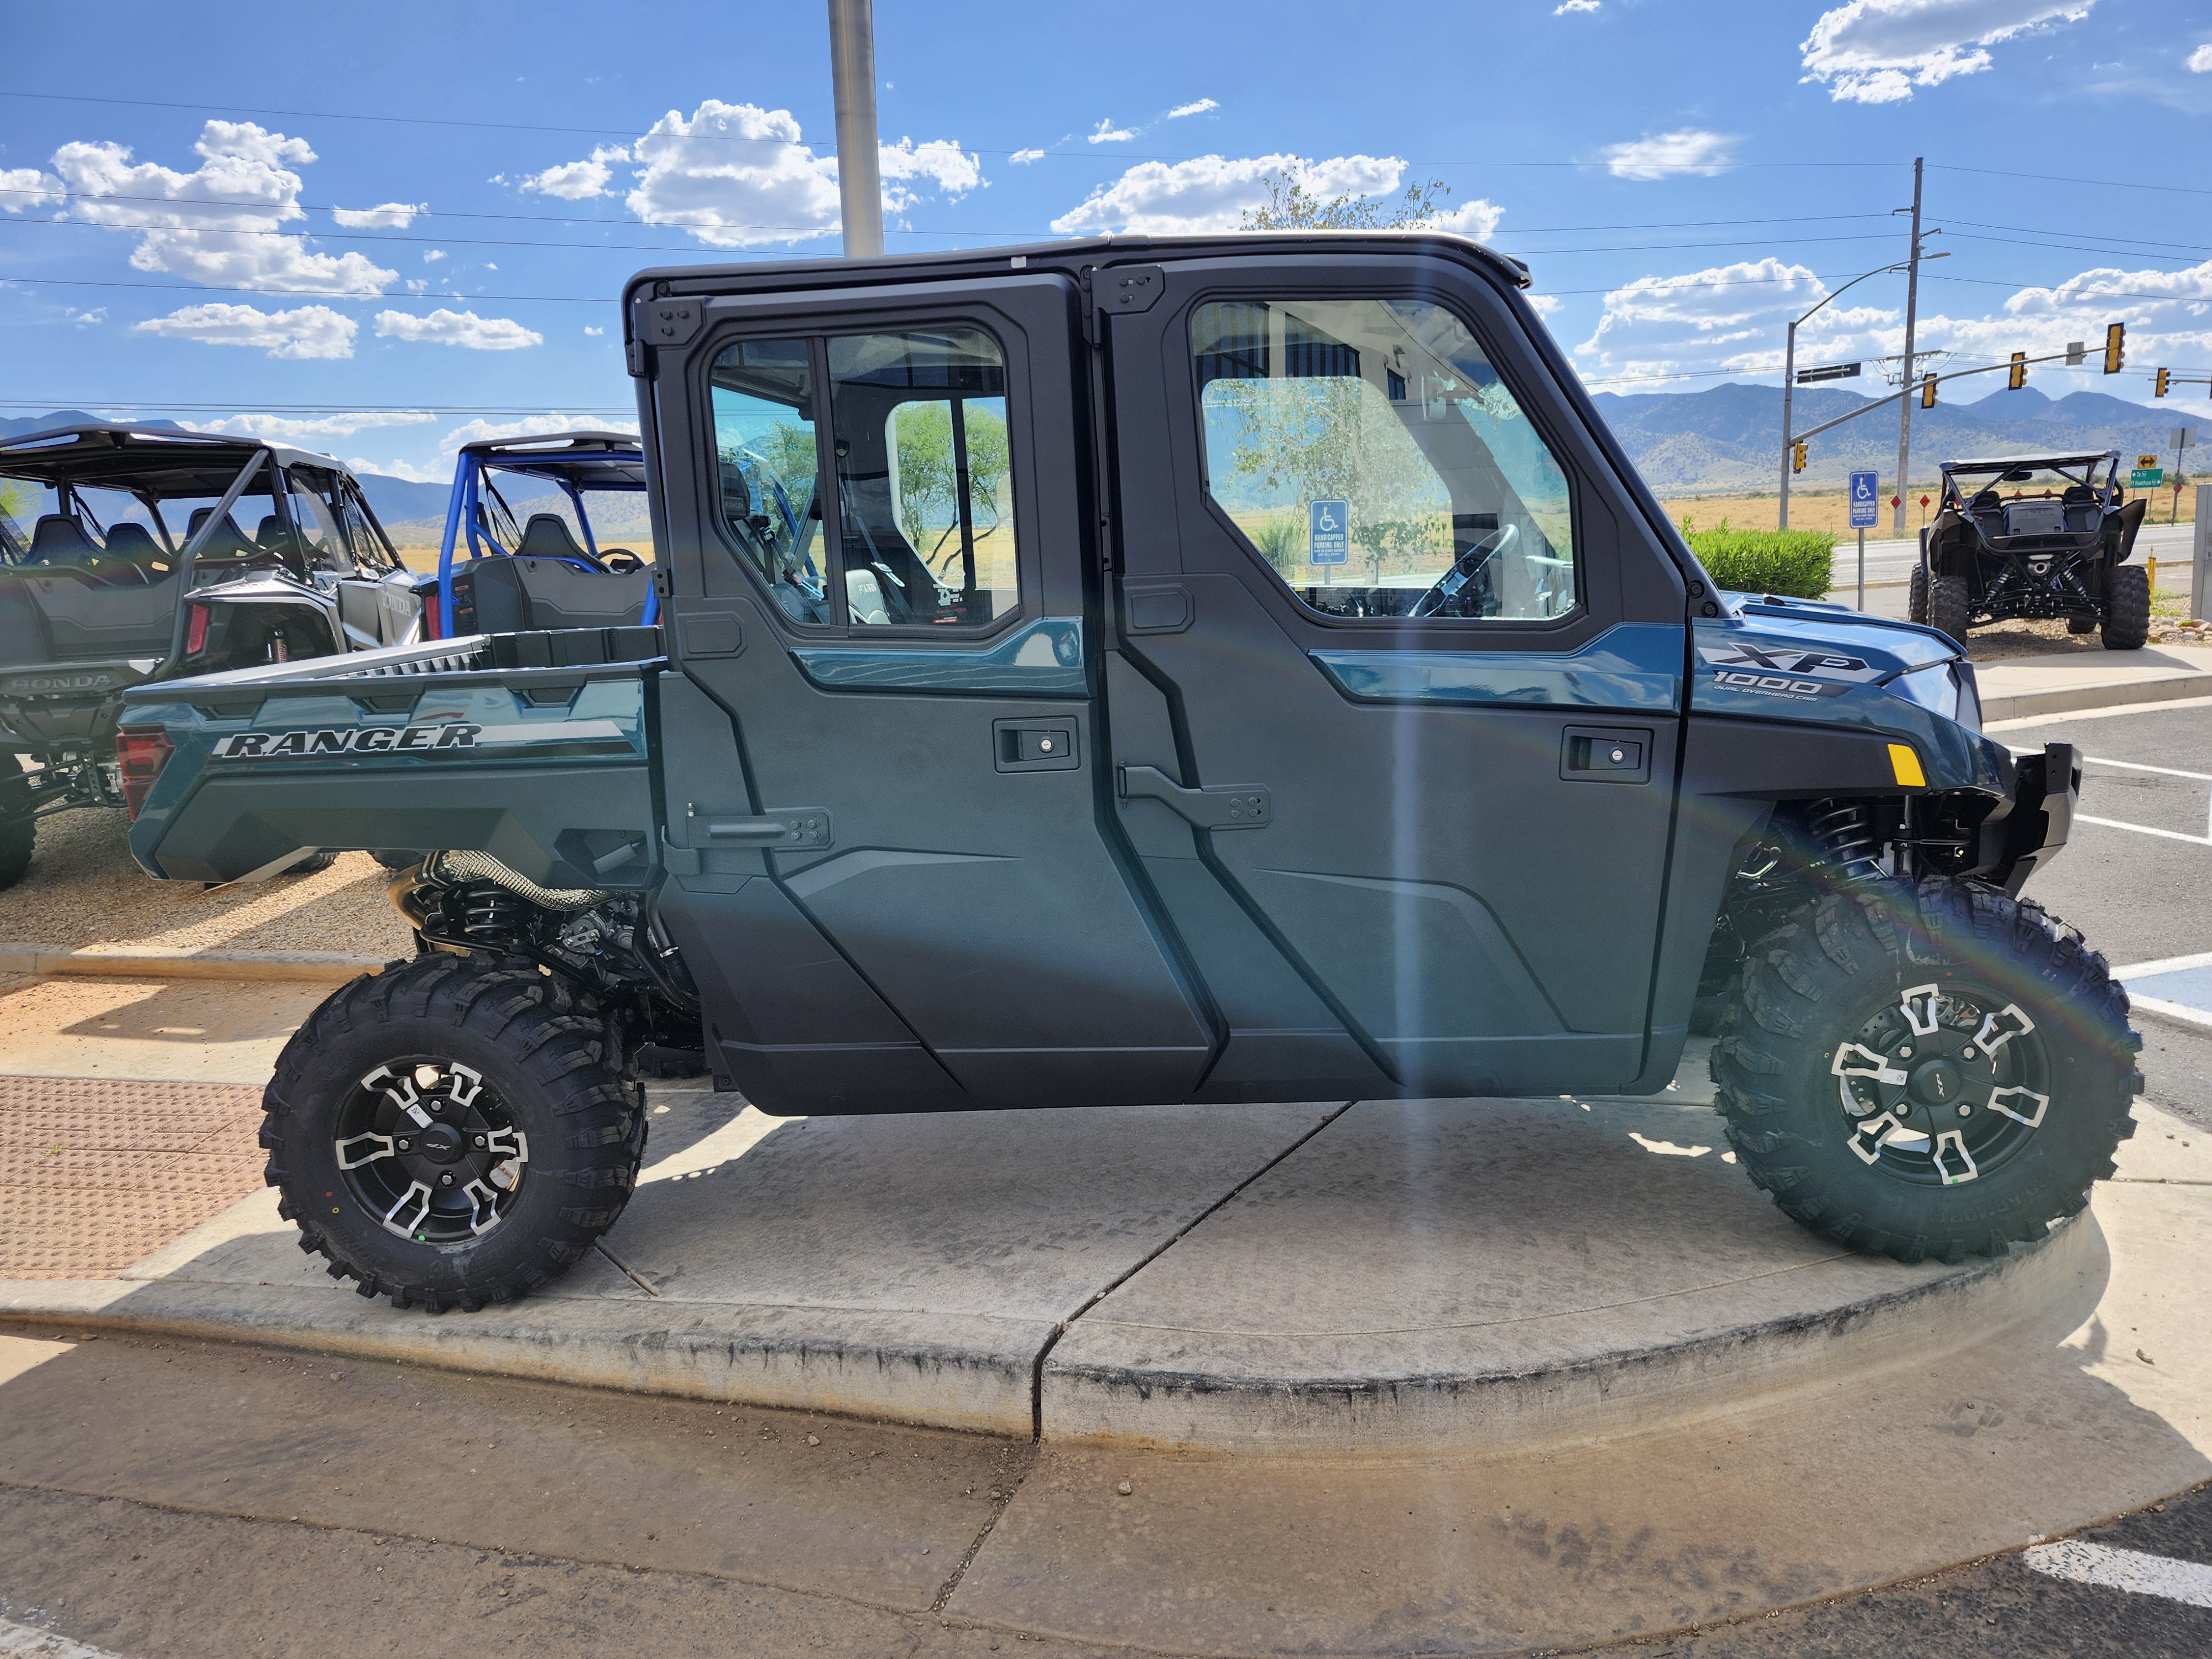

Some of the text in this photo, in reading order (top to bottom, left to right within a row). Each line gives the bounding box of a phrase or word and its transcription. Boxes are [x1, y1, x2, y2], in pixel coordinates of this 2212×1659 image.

[381, 589, 411, 618] HONDA
[1710, 642, 1870, 674] XP
[12, 675, 115, 690] HONDA
[1714, 671, 1823, 695] 1000
[1742, 688, 1794, 698] OVERHEAD
[222, 723, 482, 758] RANGER
